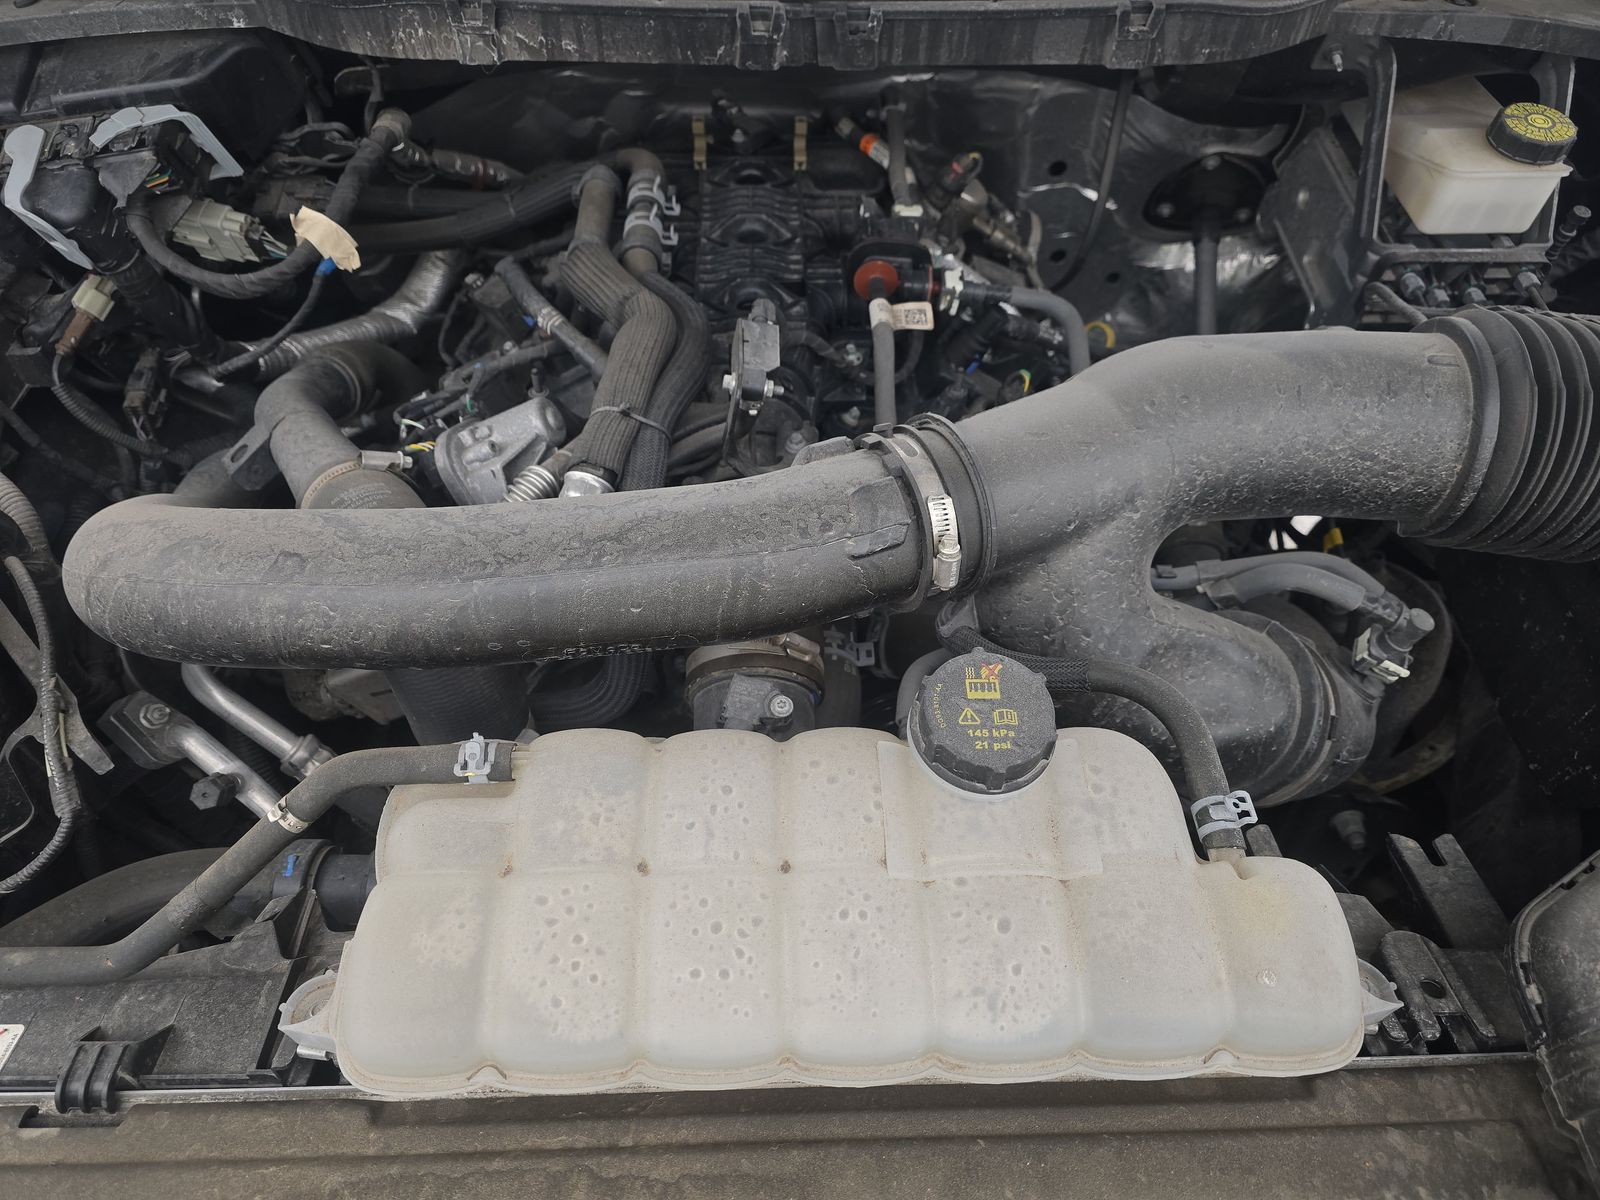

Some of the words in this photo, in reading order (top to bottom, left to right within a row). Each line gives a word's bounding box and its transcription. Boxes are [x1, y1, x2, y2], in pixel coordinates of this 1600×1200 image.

[967, 729, 989, 737] 145
[992, 729, 1016, 737] kPa
[975, 741, 988, 749] 21
[993, 740, 1011, 751] psi
